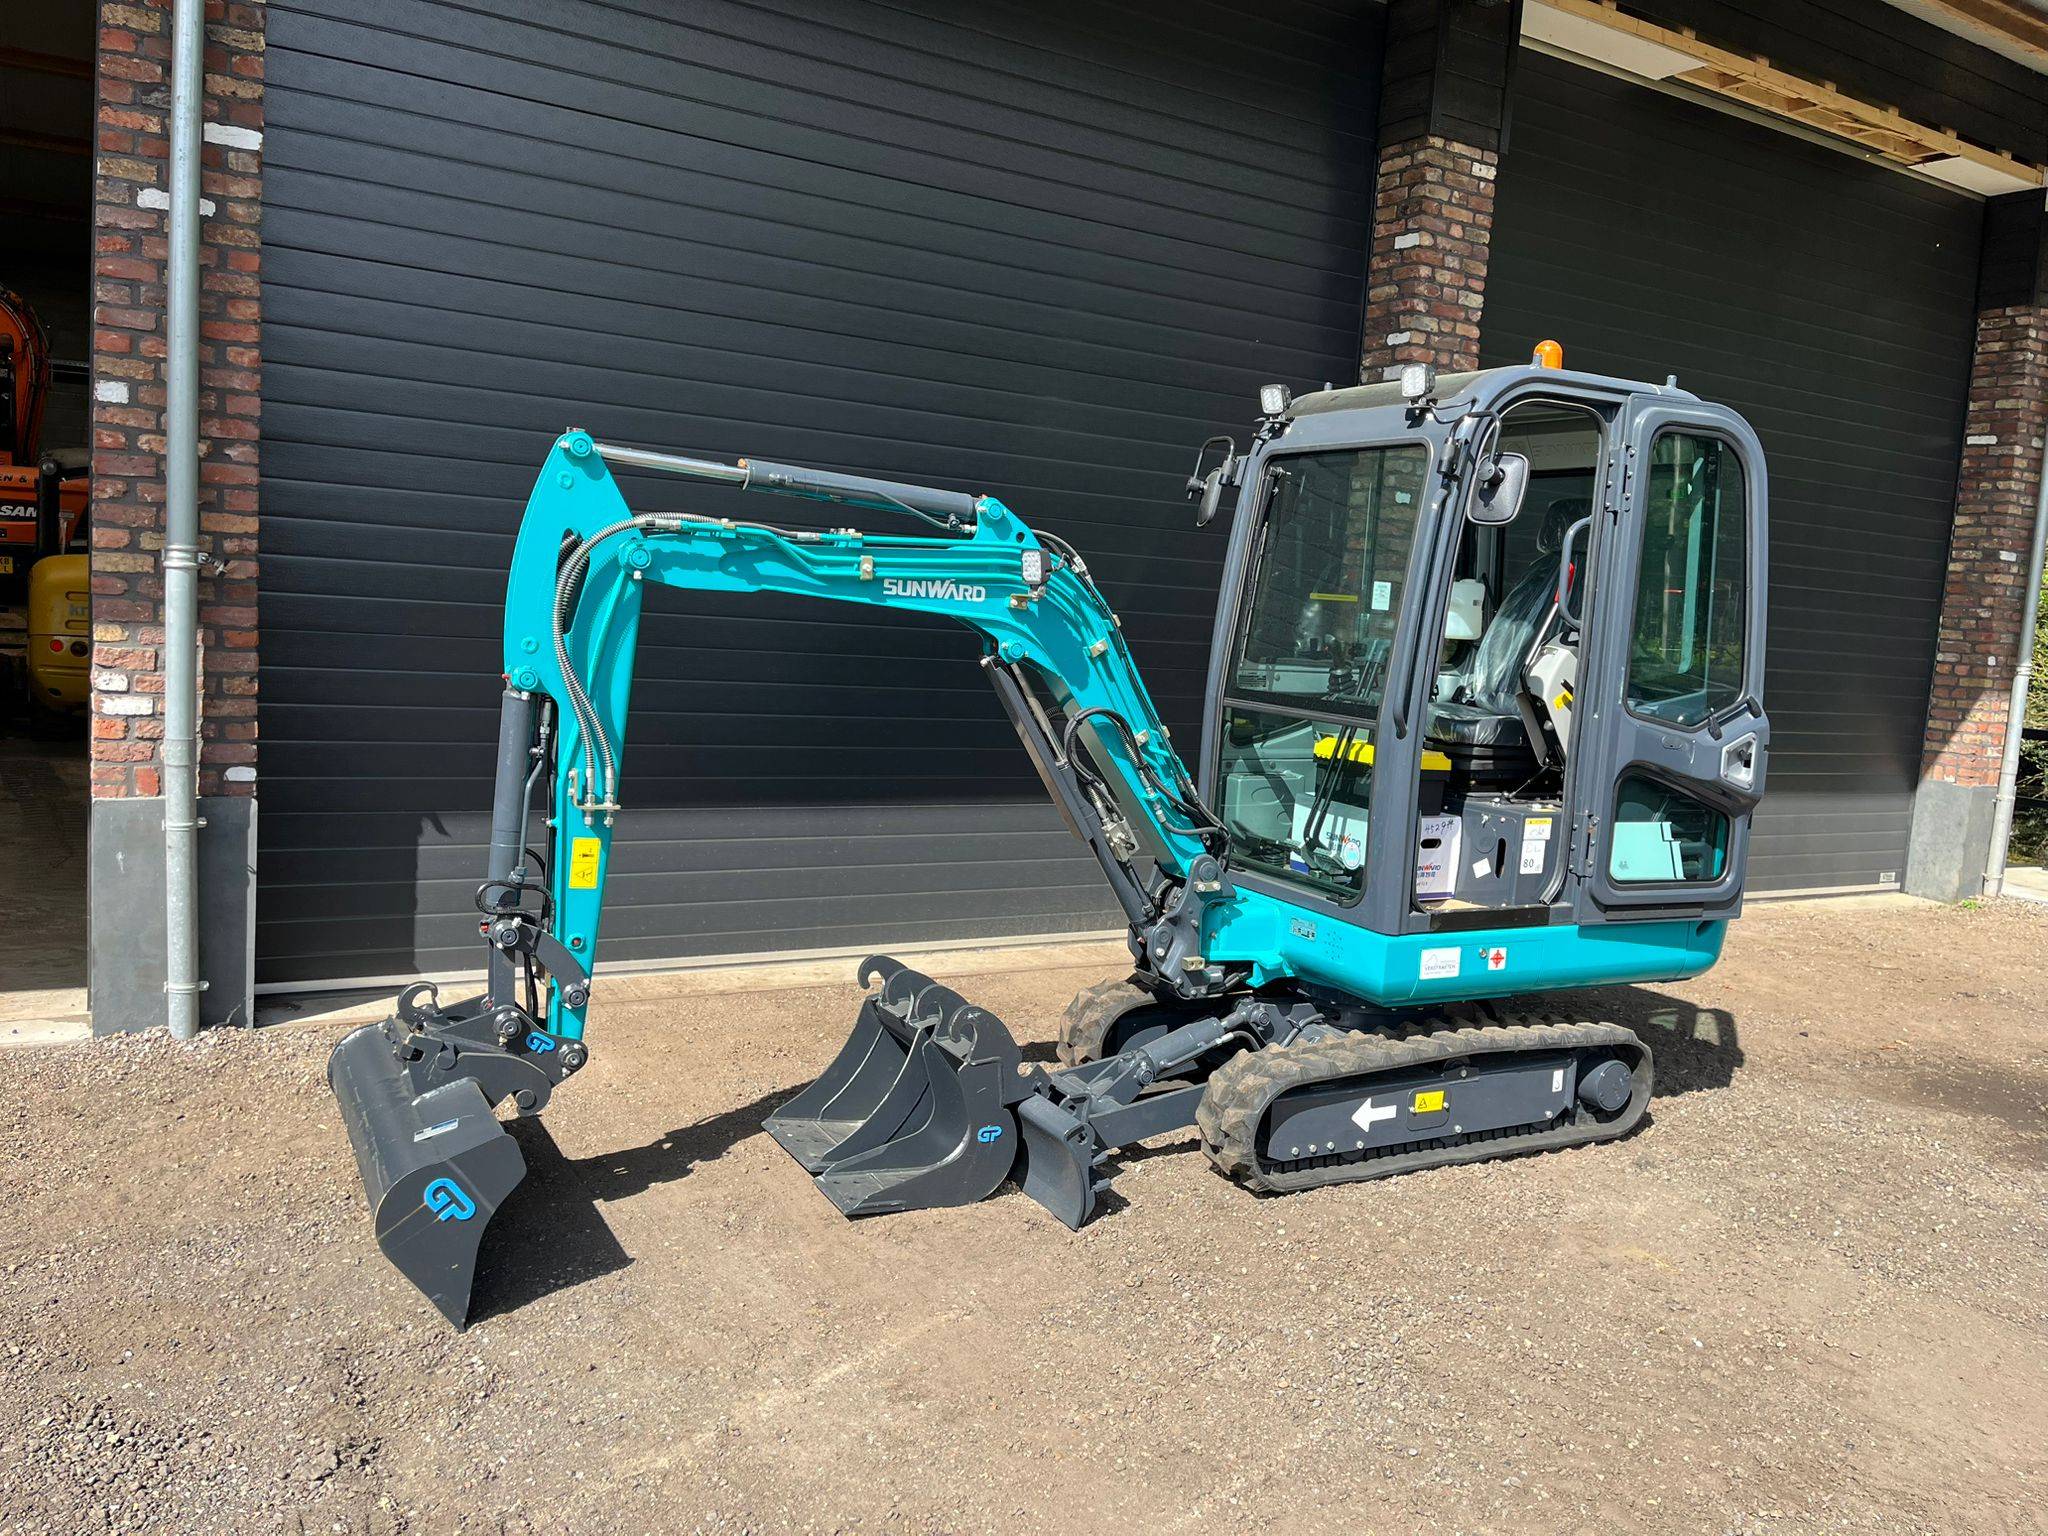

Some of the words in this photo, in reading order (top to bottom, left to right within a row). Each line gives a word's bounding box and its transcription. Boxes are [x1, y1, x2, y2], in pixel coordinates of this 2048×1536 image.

[883, 578, 986, 602] SUNWARD
[1523, 858, 1534, 868] 80
[526, 1031, 556, 1055] GP
[977, 1125, 1002, 1143] GP
[423, 1177, 477, 1222] GP
